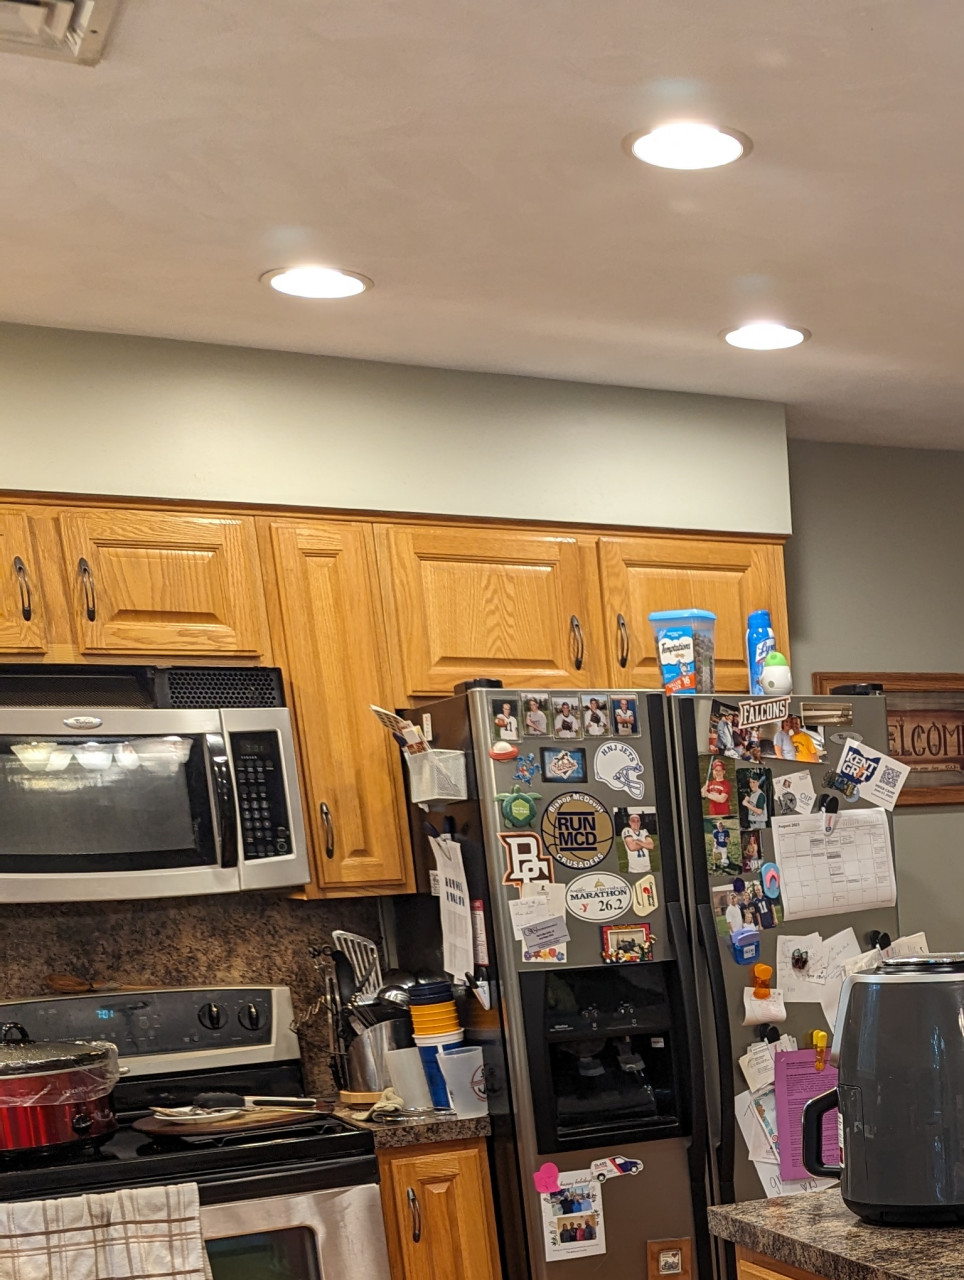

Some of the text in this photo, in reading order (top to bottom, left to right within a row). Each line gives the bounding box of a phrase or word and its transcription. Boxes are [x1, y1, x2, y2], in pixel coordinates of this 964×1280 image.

[661, 642, 691, 655] Temptations
[743, 700, 786, 724] FALCONS
[601, 745, 636, 762] HNJ JETS
[845, 751, 878, 772] KENT
[548, 796, 571, 813] Bishop
[572, 793, 604, 813] McDevitt
[557, 816, 596, 831] RUN
[559, 832, 597, 847] MCD
[556, 853, 604, 868] CRUSADERS
[570, 889, 628, 901] MARATHON
[599, 898, 623, 911] 26.2
[758, 901, 768, 913] 11
